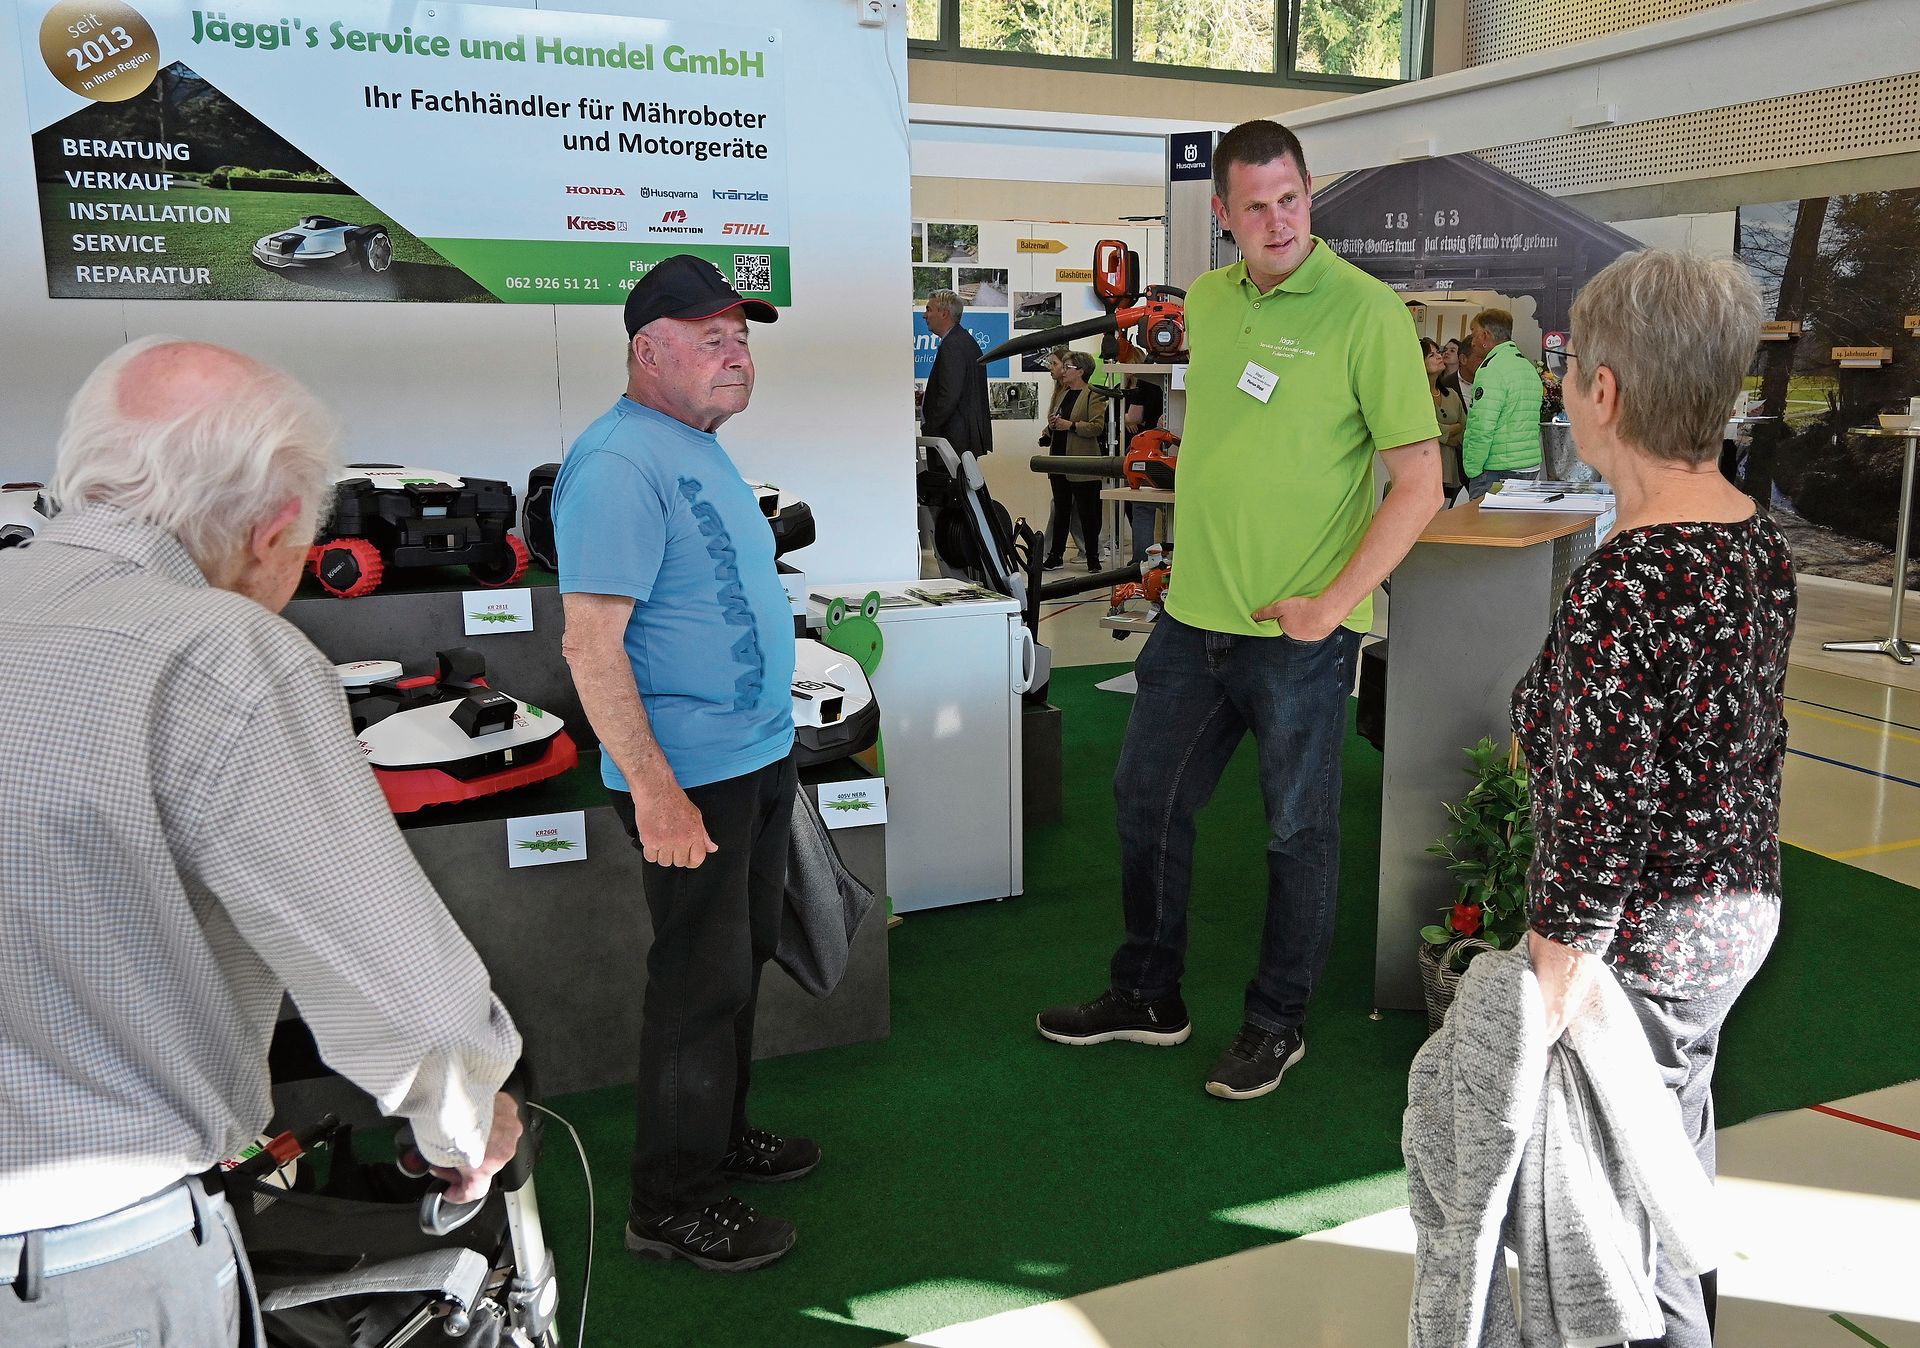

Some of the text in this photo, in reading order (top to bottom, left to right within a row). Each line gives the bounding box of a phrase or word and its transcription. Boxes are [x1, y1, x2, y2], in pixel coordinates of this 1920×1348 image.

[67, 13, 103, 39] seit
[66, 26, 134, 72] 2013
[191, 10, 765, 78] Jäggi's Service und Handel GmbH
[82, 52, 152, 91] in Ihrer Region
[364, 85, 767, 129] Ihr Fachhändler für Mähroboter
[62, 138, 190, 161] BERATUNG
[563, 130, 768, 162] und Motorgeräte
[1175, 162, 1206, 170] Husqvarna
[64, 170, 174, 191] VERKAUF
[565, 185, 625, 196] HONDA
[650, 187, 699, 200] Husqvarna
[69, 202, 231, 224] INSTALLATION
[566, 215, 616, 231] Kress
[648, 226, 704, 235] MAMMOTION
[721, 223, 770, 236] STIHL
[72, 233, 167, 253] SERVICE
[1020, 240, 1050, 249] Balzenwil
[1482, 232, 1500, 249] und
[76, 265, 212, 285] REPARATUR
[1059, 270, 1092, 279] Glashütten
[505, 277, 532, 290] 062
[534, 278, 561, 290] 926
[563, 279, 580, 290] 51
[583, 279, 600, 291] 21
[1435, 280, 1454, 289] 1937
[1844, 350, 1878, 358] Jahrhundert
[535, 828, 558, 836] KR260E
